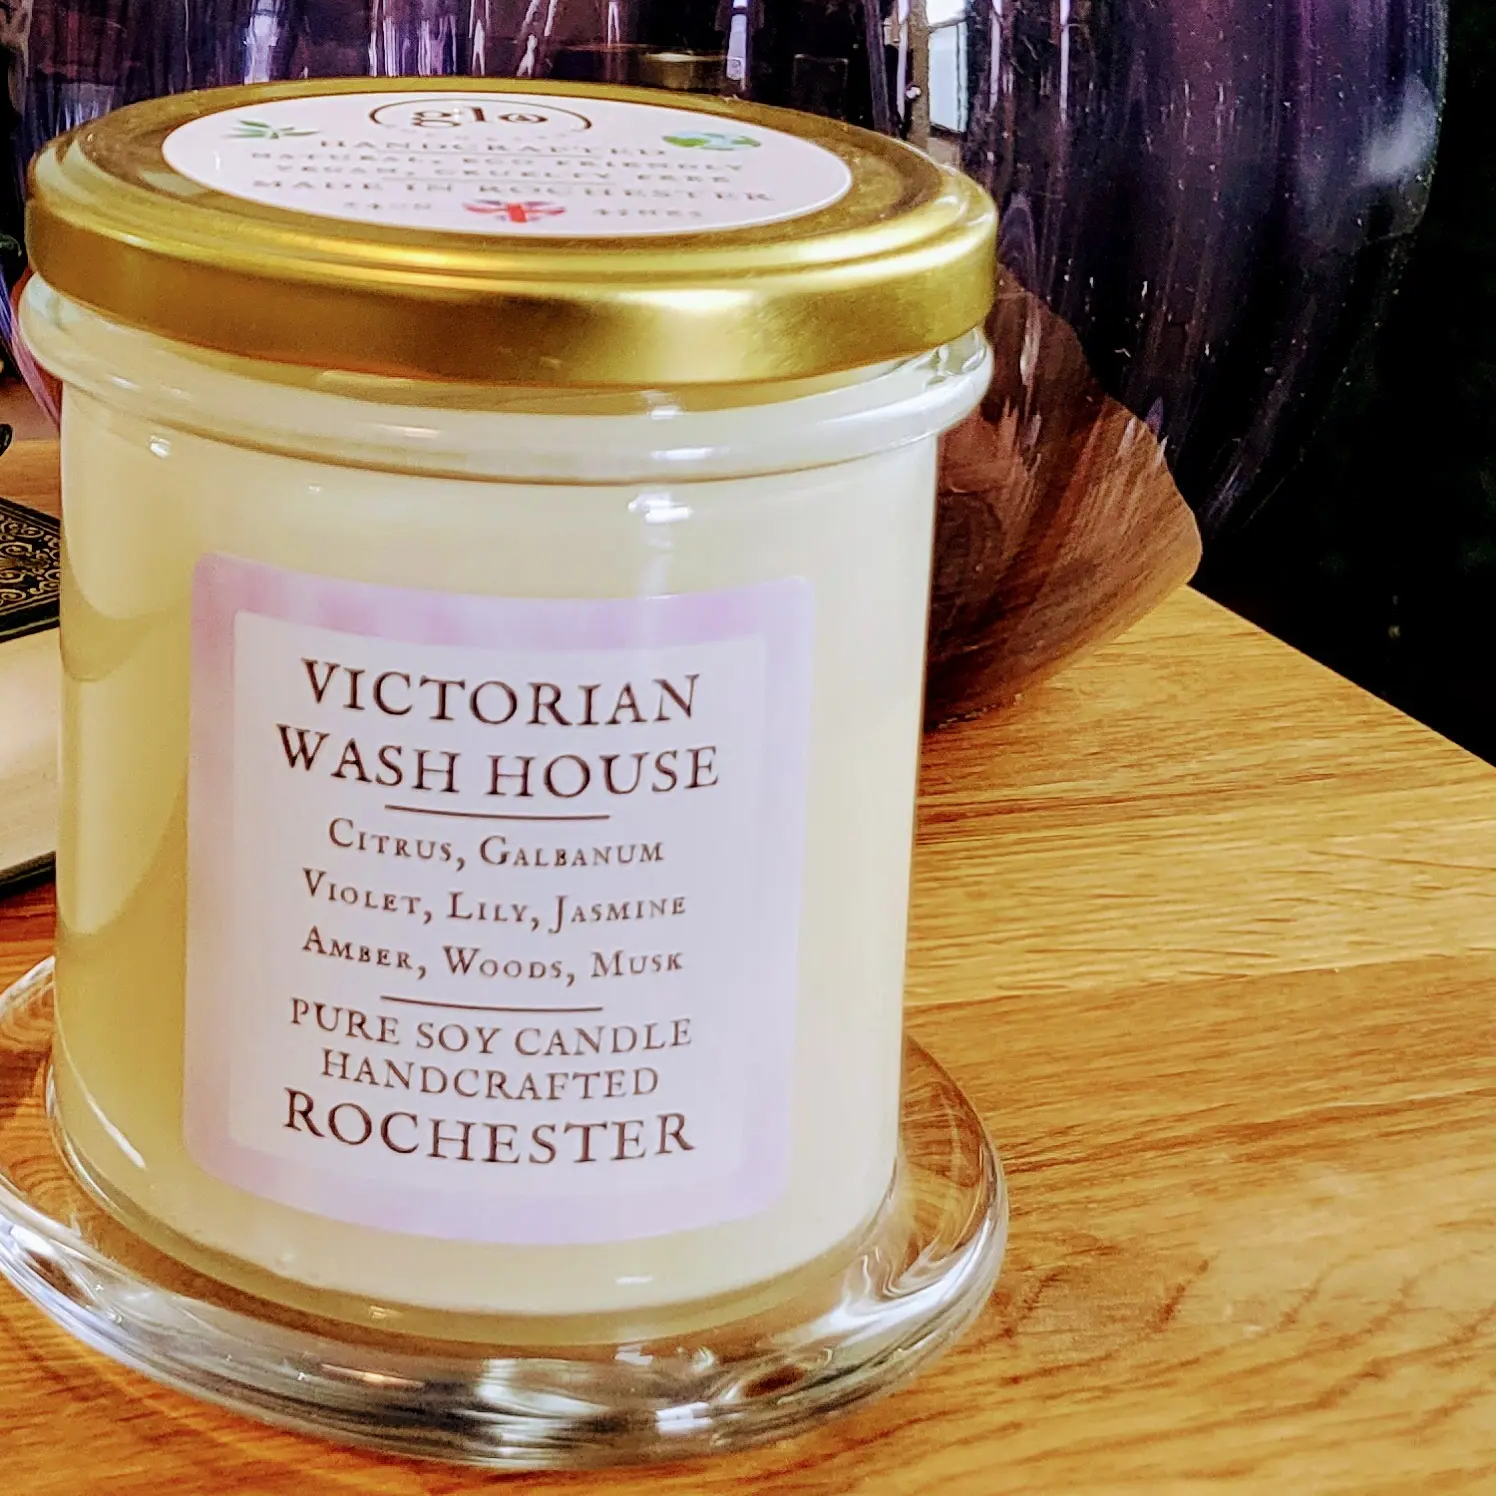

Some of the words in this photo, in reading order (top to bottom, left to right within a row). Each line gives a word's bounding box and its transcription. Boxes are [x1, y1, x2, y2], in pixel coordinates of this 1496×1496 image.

[411, 106, 548, 129] glo
[301, 657, 700, 727] VICTORIAN
[276, 723, 461, 794] WASH
[486, 745, 720, 799] HOUSE
[328, 817, 466, 872] CITRUS,
[479, 835, 665, 868] GALBANUM
[302, 867, 434, 924] VIOLET,
[446, 891, 542, 932] LILY,
[549, 895, 687, 934] JASMINE
[301, 925, 428, 980] AMBER,
[442, 945, 577, 988] WOODS,
[590, 950, 685, 979] MUSK
[290, 996, 401, 1046] PURE
[415, 1020, 503, 1056] SOY
[514, 1018, 694, 1057] CANDLE
[319, 1047, 661, 1101] HANDCRAFTED
[282, 1087, 697, 1165] ROCHESTER
